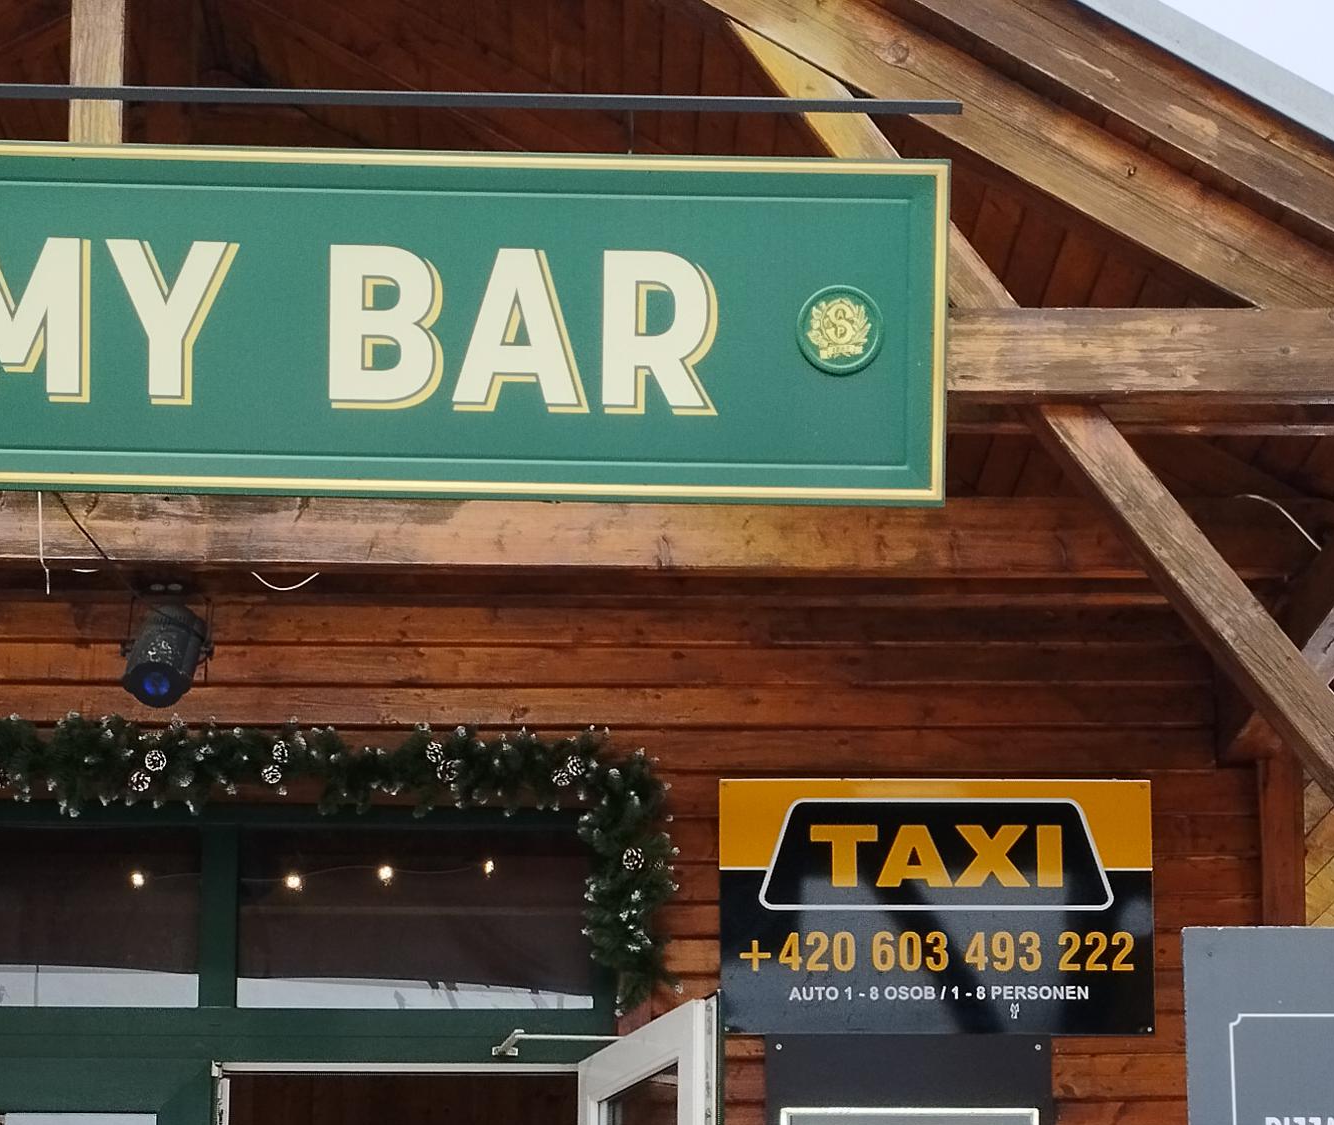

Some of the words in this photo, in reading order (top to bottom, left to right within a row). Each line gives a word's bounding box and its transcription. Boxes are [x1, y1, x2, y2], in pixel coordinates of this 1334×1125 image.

[329, 244, 718, 415] BAR
[810, 824, 1064, 887] TAXI
[872, 931, 949, 971] 603
[965, 931, 1042, 971] 493
[1058, 931, 1135, 971] 222
[789, 987, 839, 1001] AUTO
[844, 987, 853, 1000] 1
[870, 987, 879, 1000] 8
[885, 986, 936, 1000] OSOB
[951, 986, 960, 1000] 1
[977, 986, 986, 999] 8
[991, 986, 1089, 1000] PERSONEN
